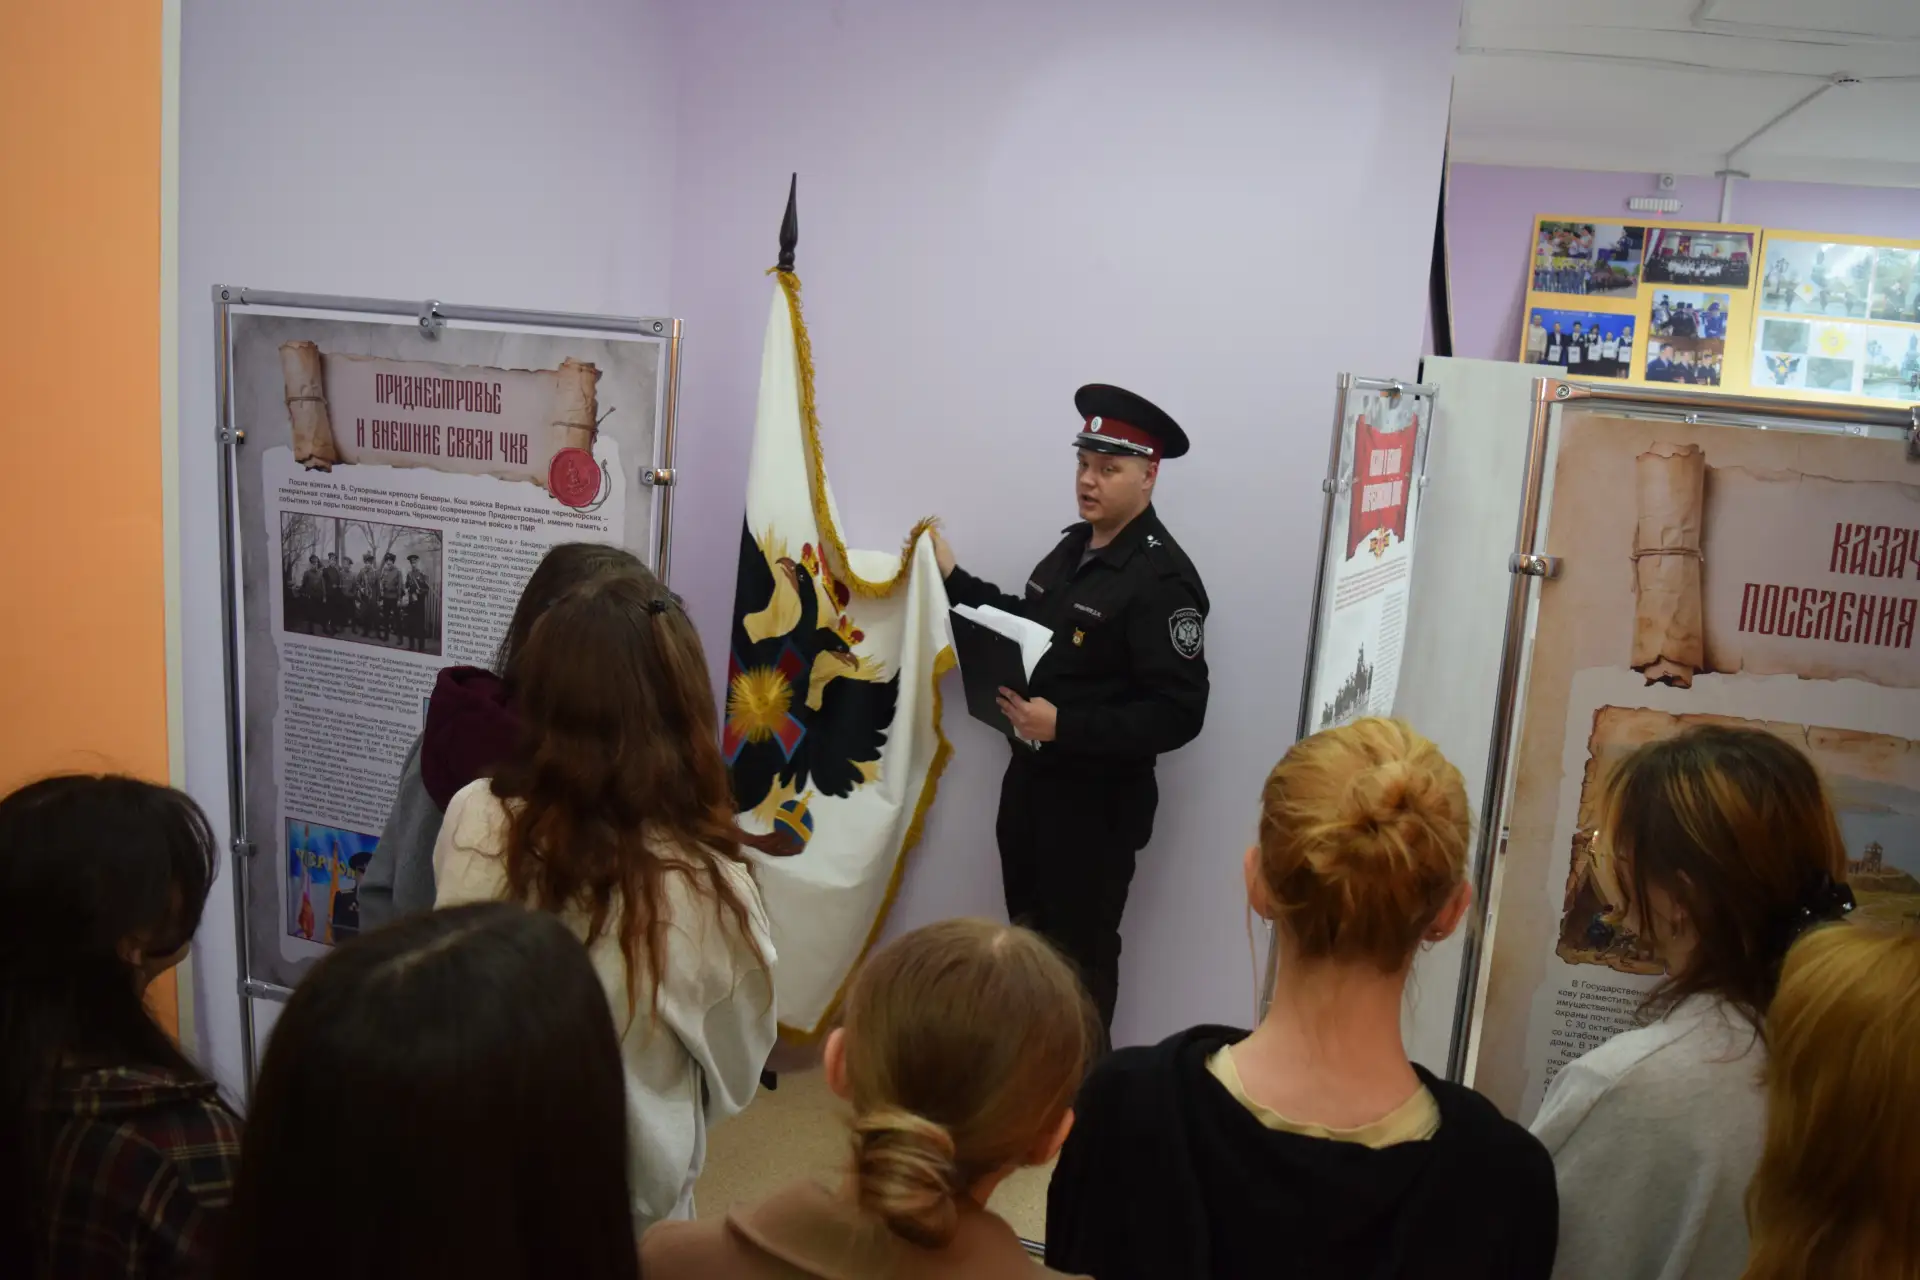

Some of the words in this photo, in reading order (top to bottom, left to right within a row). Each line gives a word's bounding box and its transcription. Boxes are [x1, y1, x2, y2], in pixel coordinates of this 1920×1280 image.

[376, 374, 501, 414] ПРИДНЕСТРОВЬЕ
[356, 418, 364, 447] И
[372, 420, 440, 455] ВНЕШНИЕ
[447, 426, 493, 460] СВЯЗИ
[499, 432, 528, 464] ЧКВ
[279, 487, 318, 497] генеральная
[344, 493, 357, 501] был
[359, 496, 393, 506] перенесен
[401, 500, 438, 510] Слободзею
[440, 504, 487, 516] (современное
[547, 519, 574, 528] именно
[576, 523, 601, 531] память
[349, 484, 387, 495] Суворовым
[389, 491, 419, 499] крепости
[454, 497, 468, 505] Кош
[470, 500, 493, 508] войска
[495, 502, 521, 511] Верных
[523, 507, 550, 515] казаков
[552, 510, 602, 521] черноморских
[412, 511, 460, 523] Черноморское
[489, 521, 513, 530] войско
[1738, 583, 1918, 648] ПОСЕЛЕНИЯ
[1571, 979, 1578, 988] В
[1558, 989, 1577, 1000] кову
[1555, 999, 1622, 1014] имущественно
[1554, 1009, 1588, 1020] охраны
[1565, 1019, 1573, 1028] С
[1575, 1020, 1586, 1029] 30
[1588, 1024, 1624, 1035] октября
[1551, 1029, 1563, 1037] со
[1564, 1030, 1599, 1042] штабом
[1549, 1038, 1576, 1049] доны.
[1578, 1041, 1585, 1050] В
[1561, 1048, 1583, 1058] Каза
